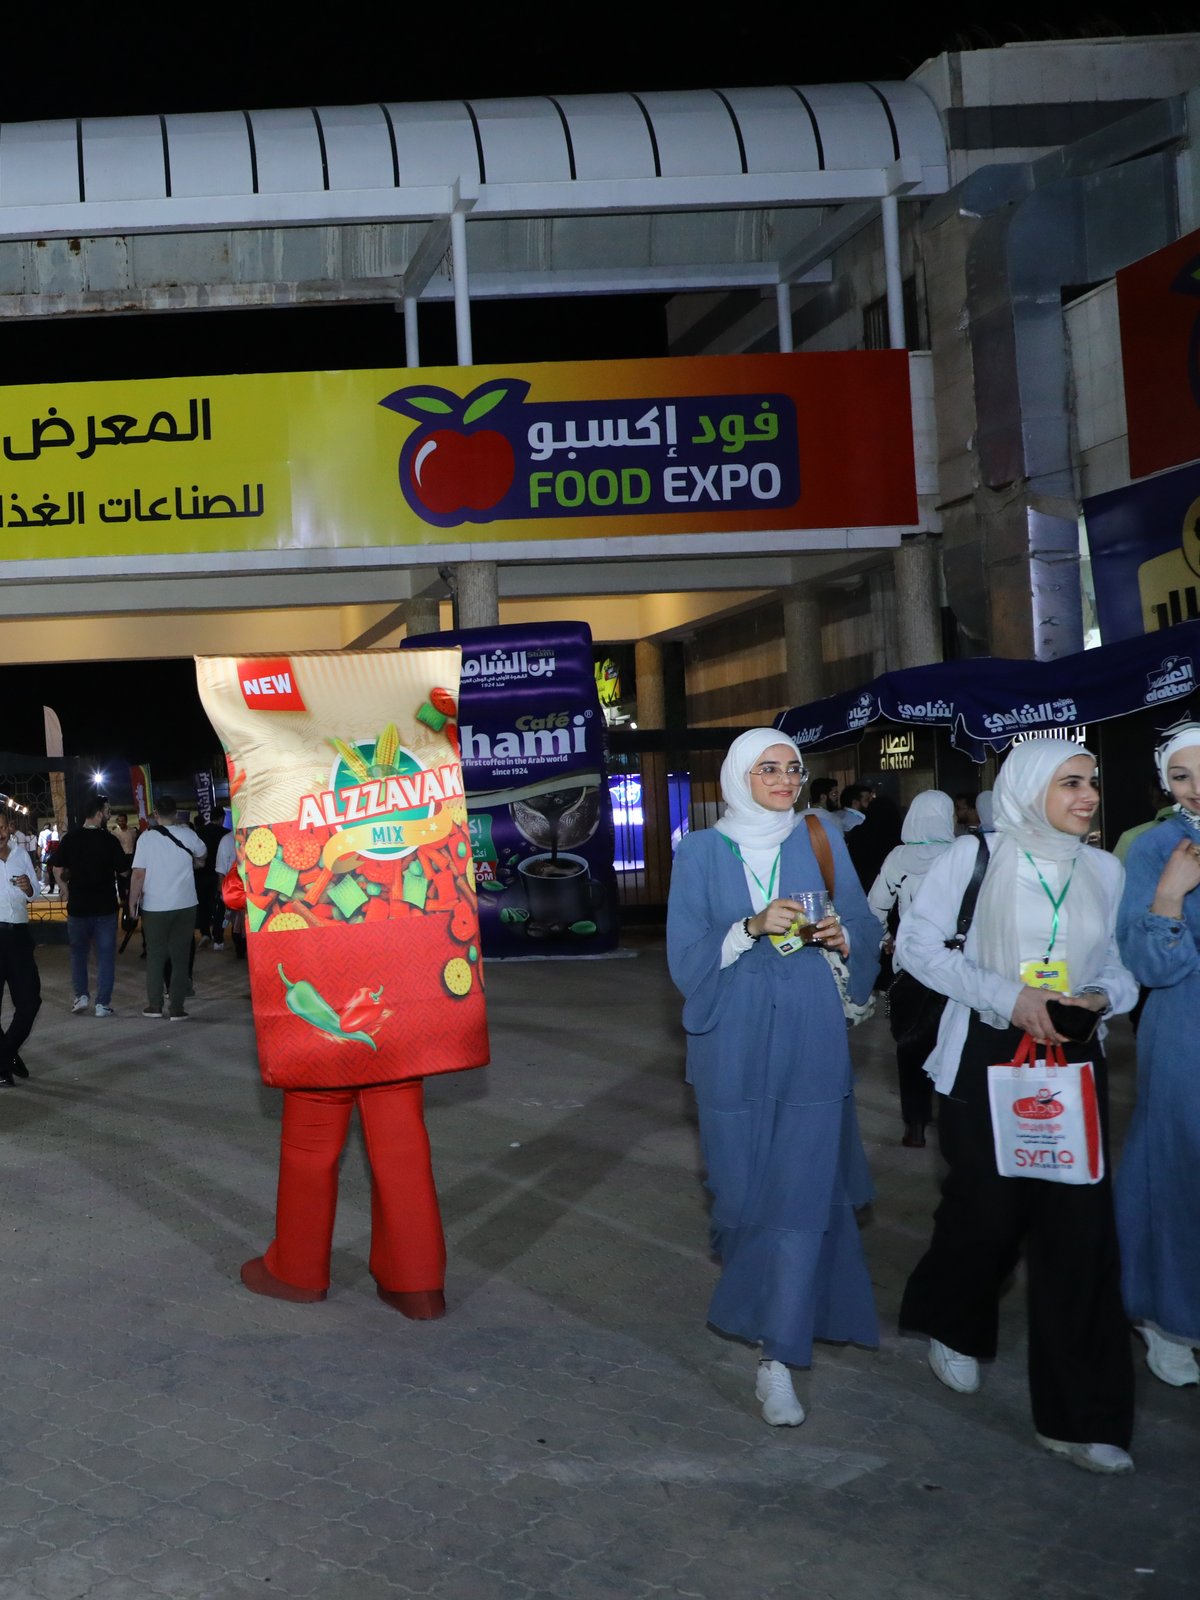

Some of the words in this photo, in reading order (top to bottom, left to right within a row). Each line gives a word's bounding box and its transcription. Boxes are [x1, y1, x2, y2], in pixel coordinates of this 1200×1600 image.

[3, 398, 211, 461] المعرض
[527, 405, 677, 461] إكسبو
[692, 402, 780, 453] فود
[530, 468, 651, 508] FOOD
[663, 462, 781, 503] EXPO
[98, 483, 265, 524] للصناعات
[461, 649, 528, 678] الشام
[528, 657, 556, 678] بن
[243, 672, 293, 696] NEW
[1145, 680, 1194, 702] alattar
[515, 711, 570, 731] Café
[898, 699, 954, 719] لشامي
[982, 702, 1054, 734] الشامي
[1053, 703, 1078, 722] بن
[460, 714, 587, 759] hami
[880, 730, 915, 755] العطار
[465, 758, 482, 767] first
[482, 758, 506, 767] coffee
[506, 757, 514, 765] in
[514, 757, 528, 765] the
[528, 755, 546, 764] Arab
[546, 754, 568, 763] world
[492, 768, 511, 776] since
[511, 767, 529, 776] 1924
[880, 753, 915, 771] alattar
[299, 763, 463, 830] ALZZAVAK
[372, 825, 405, 846] MIX
